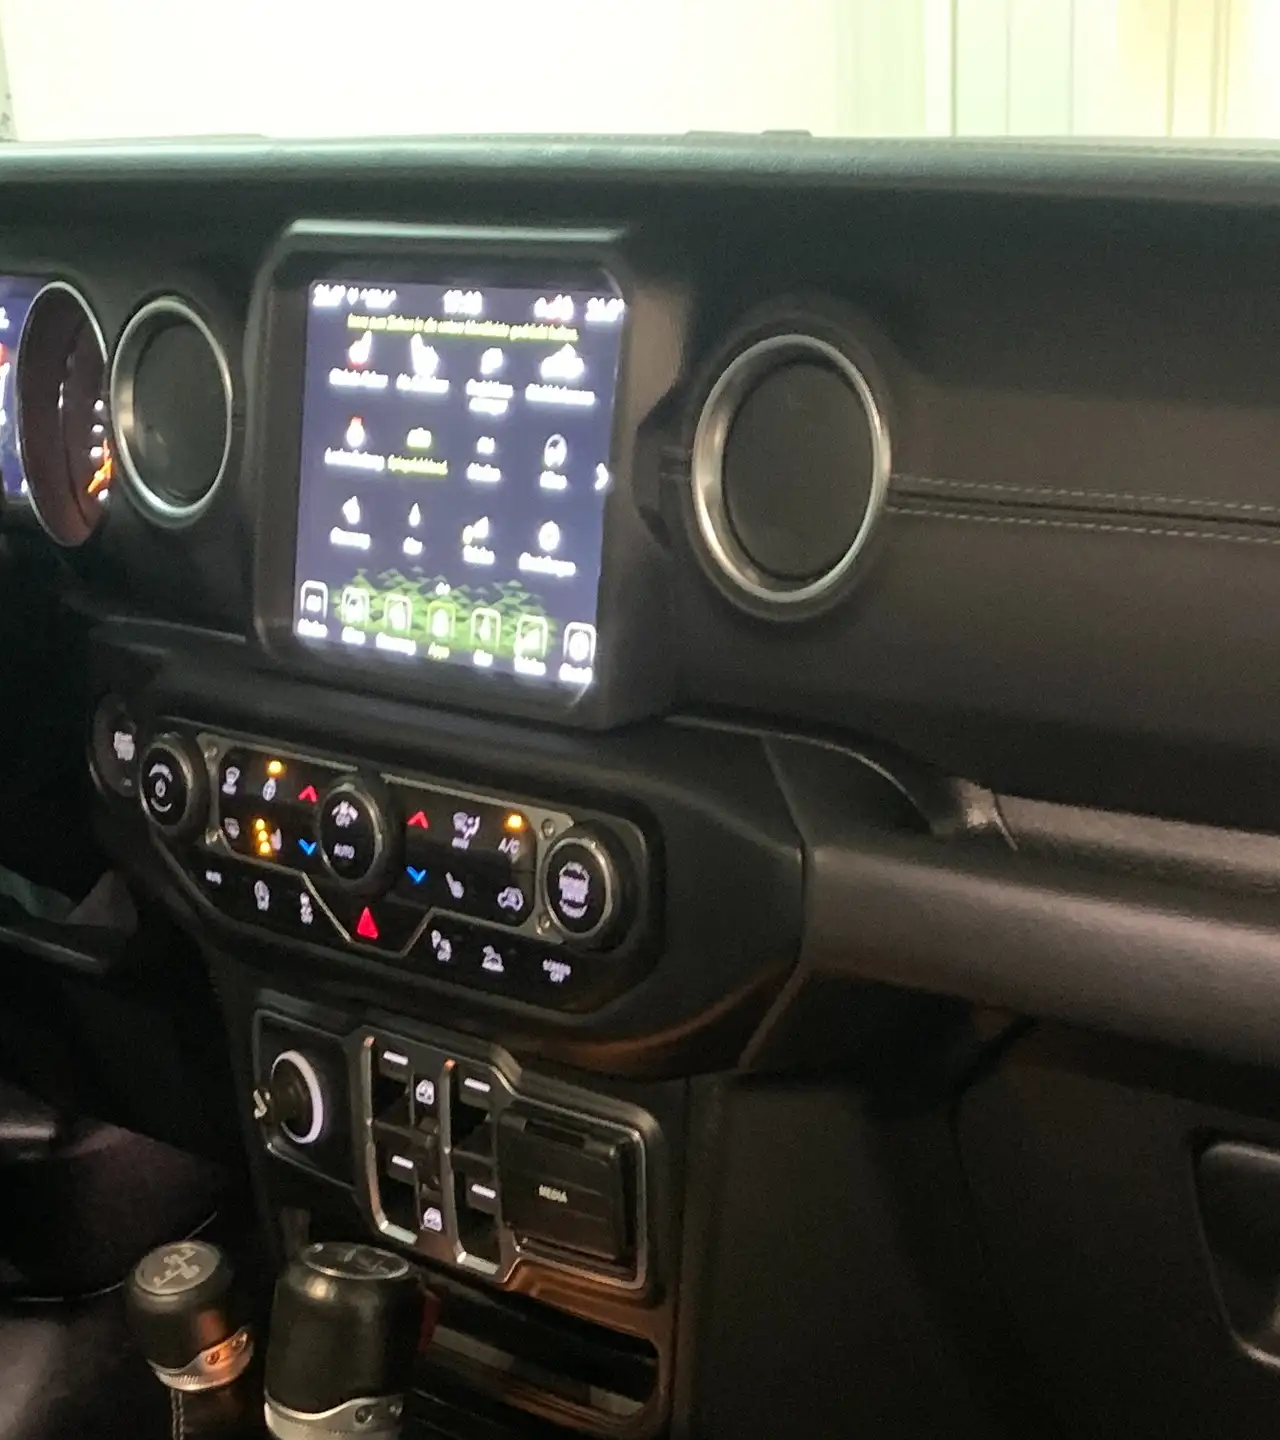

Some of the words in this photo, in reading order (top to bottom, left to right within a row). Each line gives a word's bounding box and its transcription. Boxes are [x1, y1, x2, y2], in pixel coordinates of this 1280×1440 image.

[333, 842, 355, 859] AUTO
[497, 837, 521, 855] A/C
[538, 1184, 568, 1203] MEDIA
